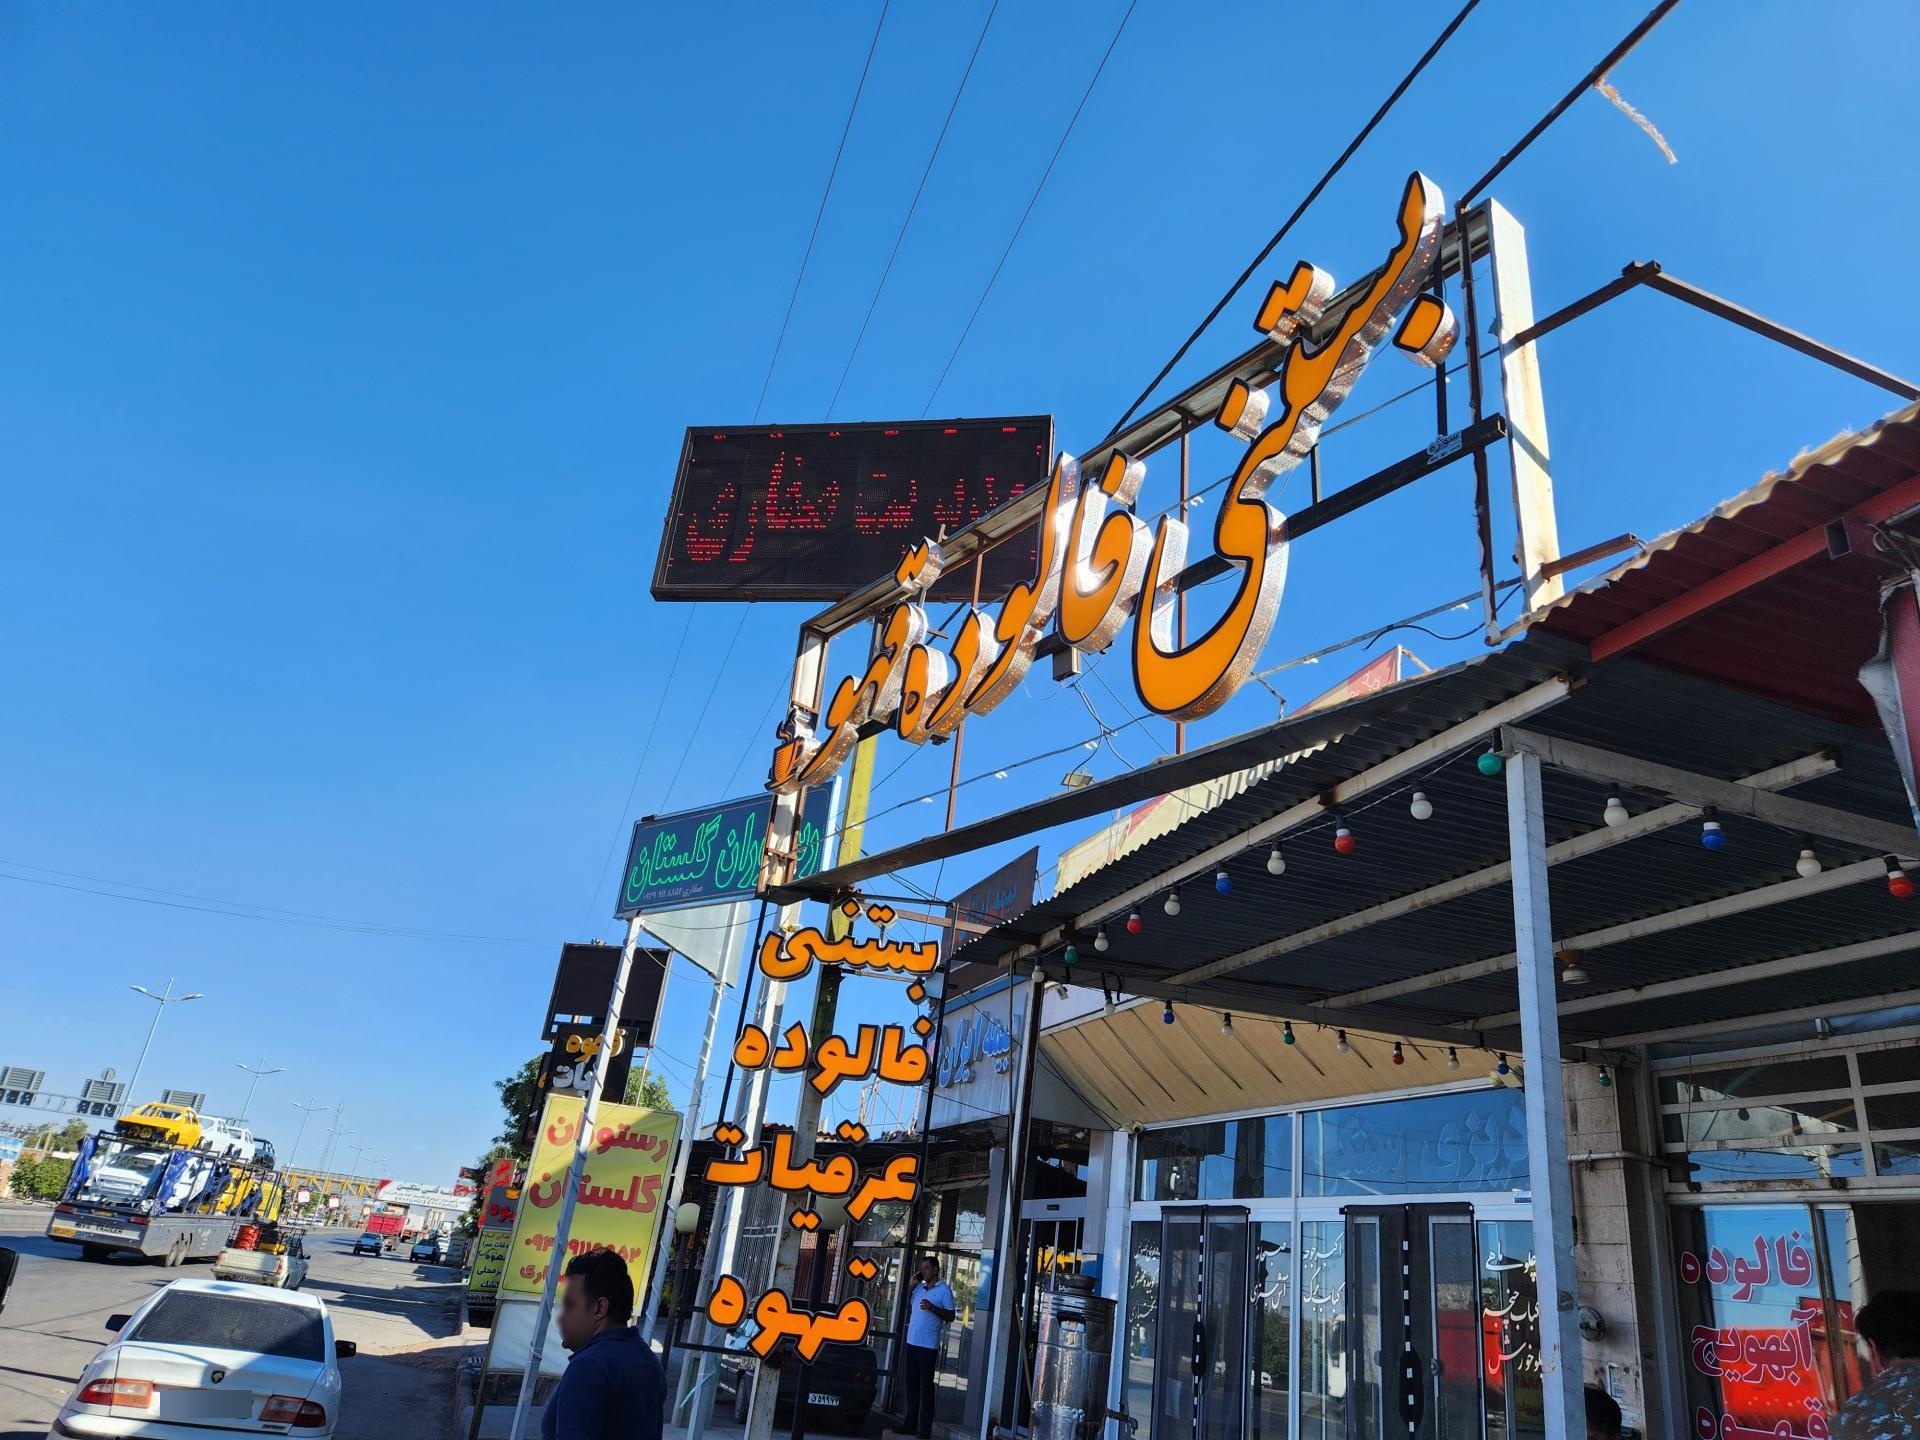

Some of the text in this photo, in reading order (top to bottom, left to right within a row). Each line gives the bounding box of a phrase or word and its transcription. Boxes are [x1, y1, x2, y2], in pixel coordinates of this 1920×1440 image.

[1132, 171, 1460, 722] بستنی
[898, 449, 1147, 746] فالوده
[628, 814, 722, 903] گلستان
[759, 898, 941, 1006] بستنی
[733, 1014, 936, 1098] فالوده
[939, 1010, 1011, 1089] بیمه ایران
[547, 1112, 668, 1163] رستوان
[703, 1119, 921, 1233] عرقیات
[1485, 1241, 1523, 1271] ماهی
[1681, 1229, 1813, 1302] فالوده
[706, 1255, 880, 1366] قهوه
